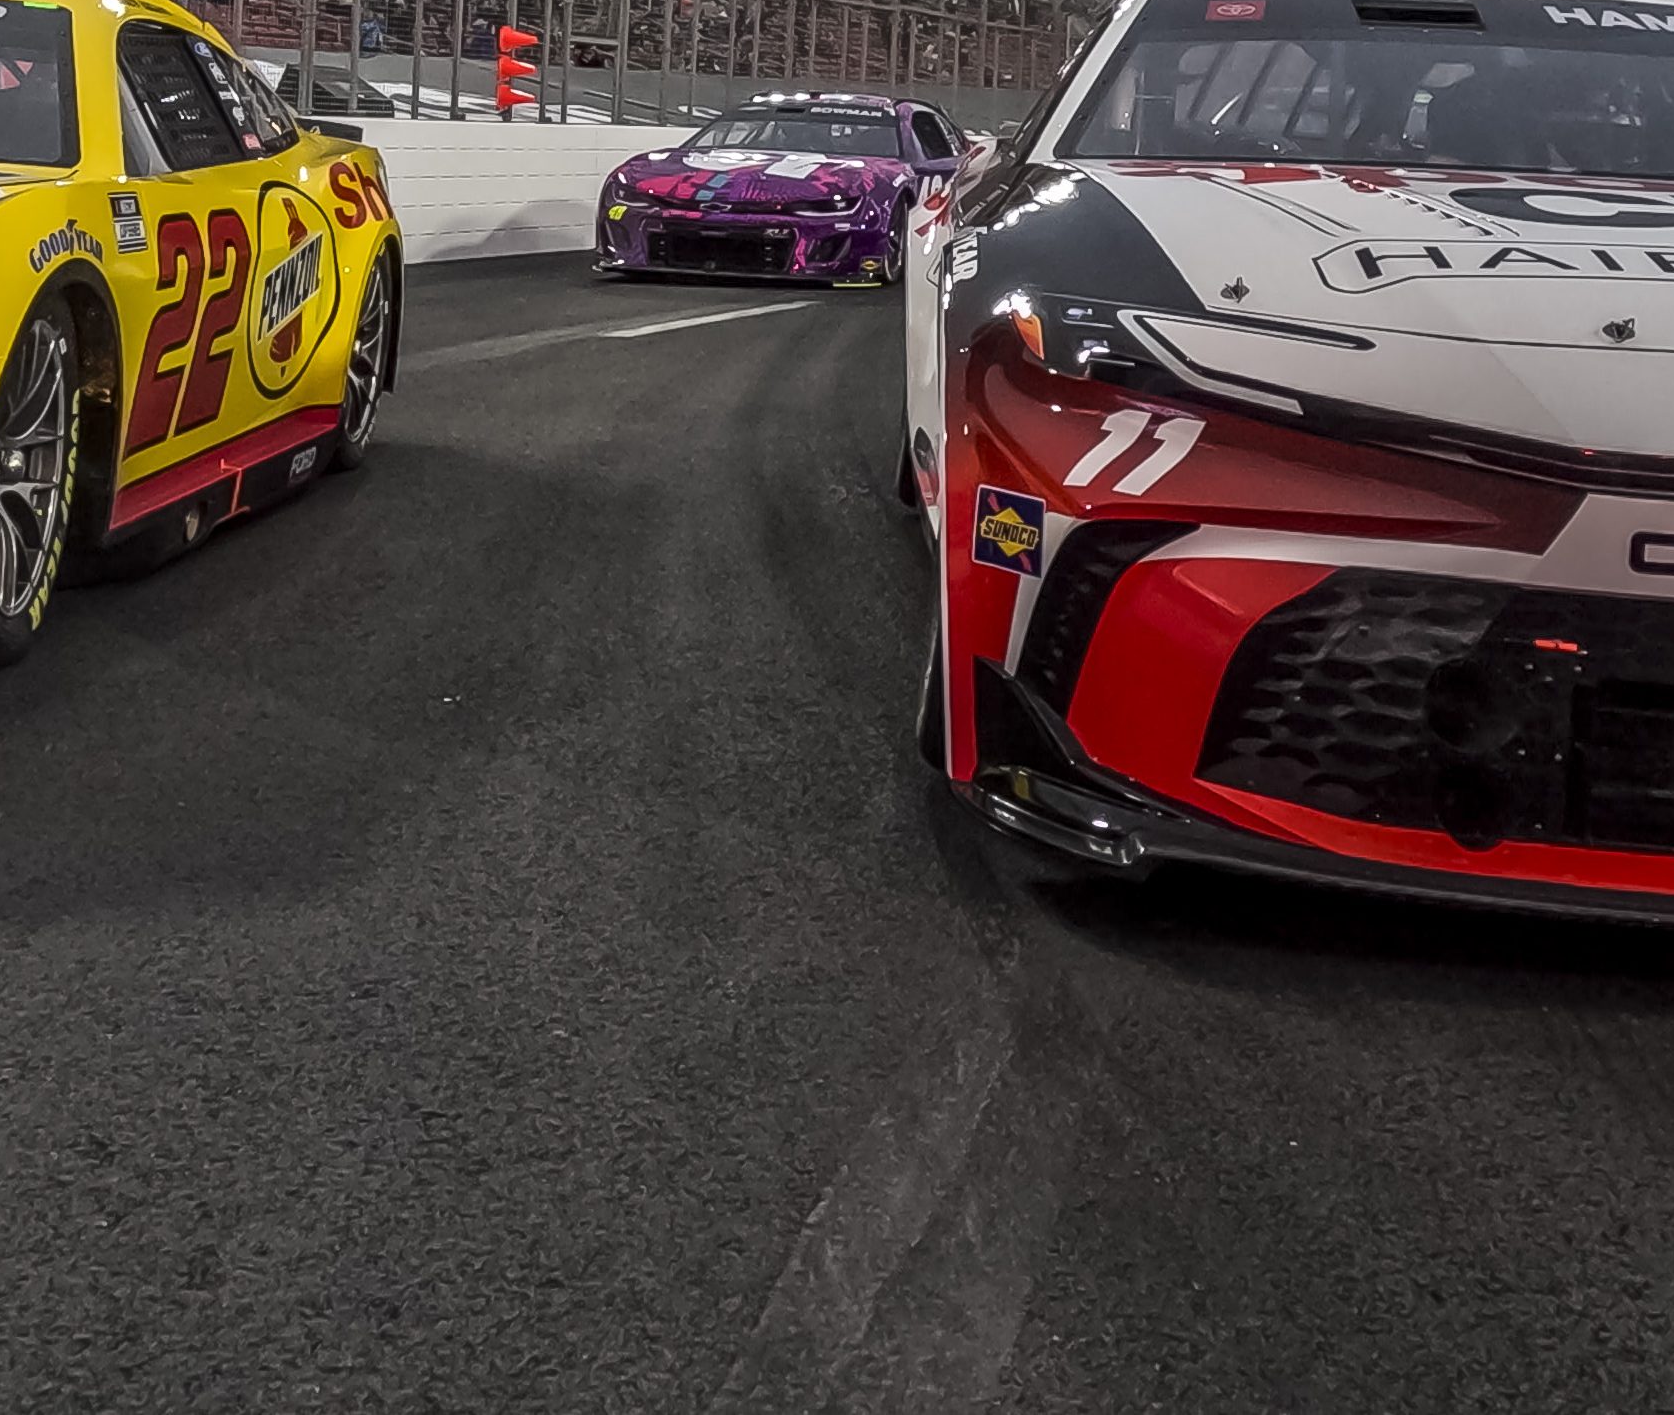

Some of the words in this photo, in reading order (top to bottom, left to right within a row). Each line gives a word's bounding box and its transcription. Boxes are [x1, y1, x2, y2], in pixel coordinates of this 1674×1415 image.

[811, 107, 882, 117] BOWMAN
[30, 219, 103, 273] GOODYEAR
[257, 234, 323, 343] PENNZOIL
[126, 209, 252, 459] 22
[1063, 410, 1206, 496] 11
[983, 518, 1038, 548] SUNOCO
